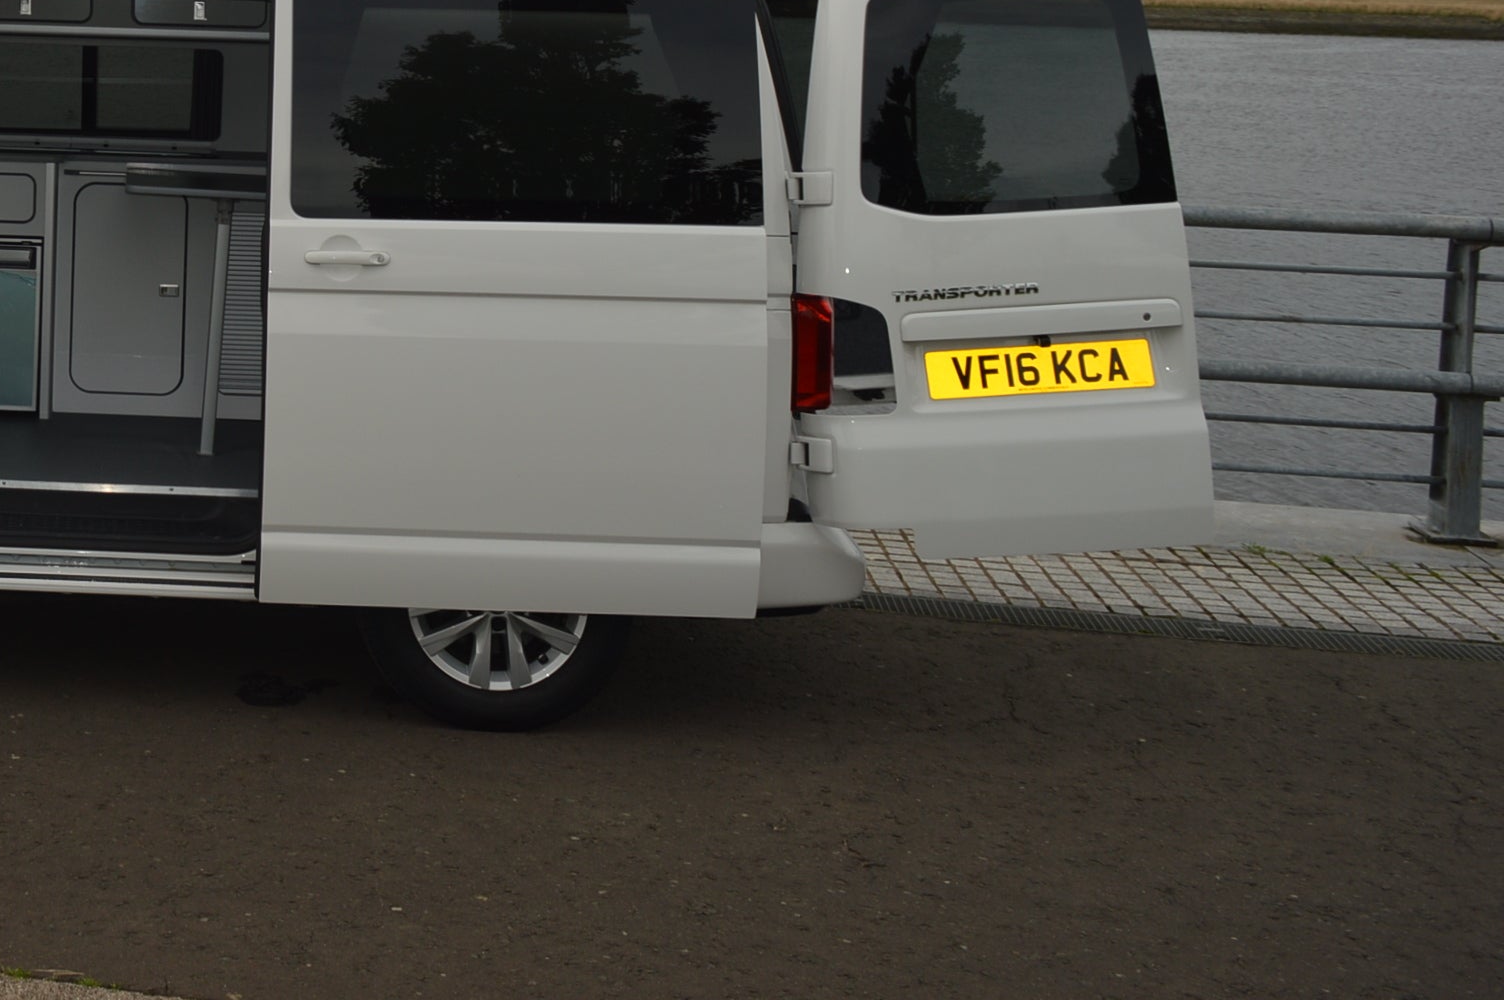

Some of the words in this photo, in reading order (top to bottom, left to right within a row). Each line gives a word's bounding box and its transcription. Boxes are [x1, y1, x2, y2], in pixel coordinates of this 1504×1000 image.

[892, 282, 1040, 303] TRANSPORTER
[952, 352, 1040, 389] VF16
[1051, 347, 1129, 384] KCA
